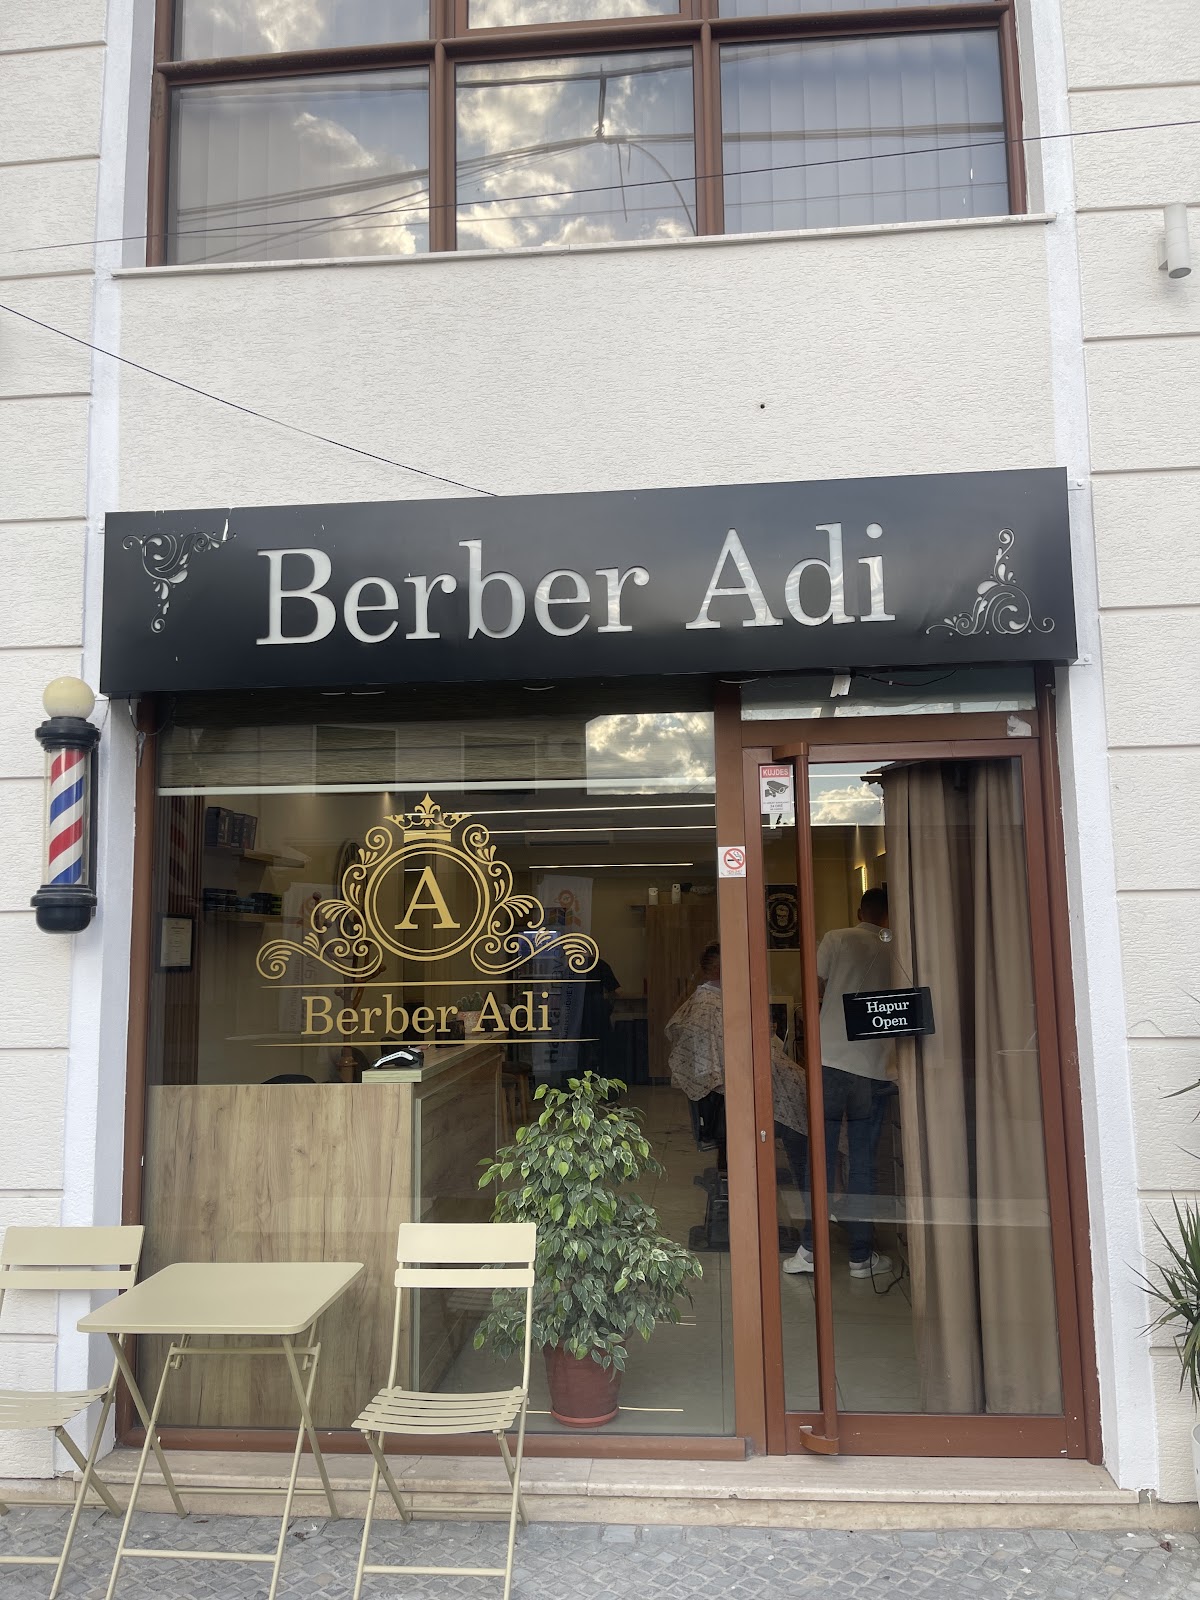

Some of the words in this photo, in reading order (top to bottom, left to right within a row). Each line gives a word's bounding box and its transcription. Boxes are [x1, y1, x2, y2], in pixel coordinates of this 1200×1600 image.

[256, 539, 650, 645] Berber
[685, 522, 896, 630] Adi
[762, 768, 789, 777] KUJDES
[394, 866, 461, 930] A
[301, 991, 459, 1036] Berber
[472, 990, 553, 1033] Adi
[865, 1000, 910, 1015] Hapur
[872, 1015, 909, 1030] Open
